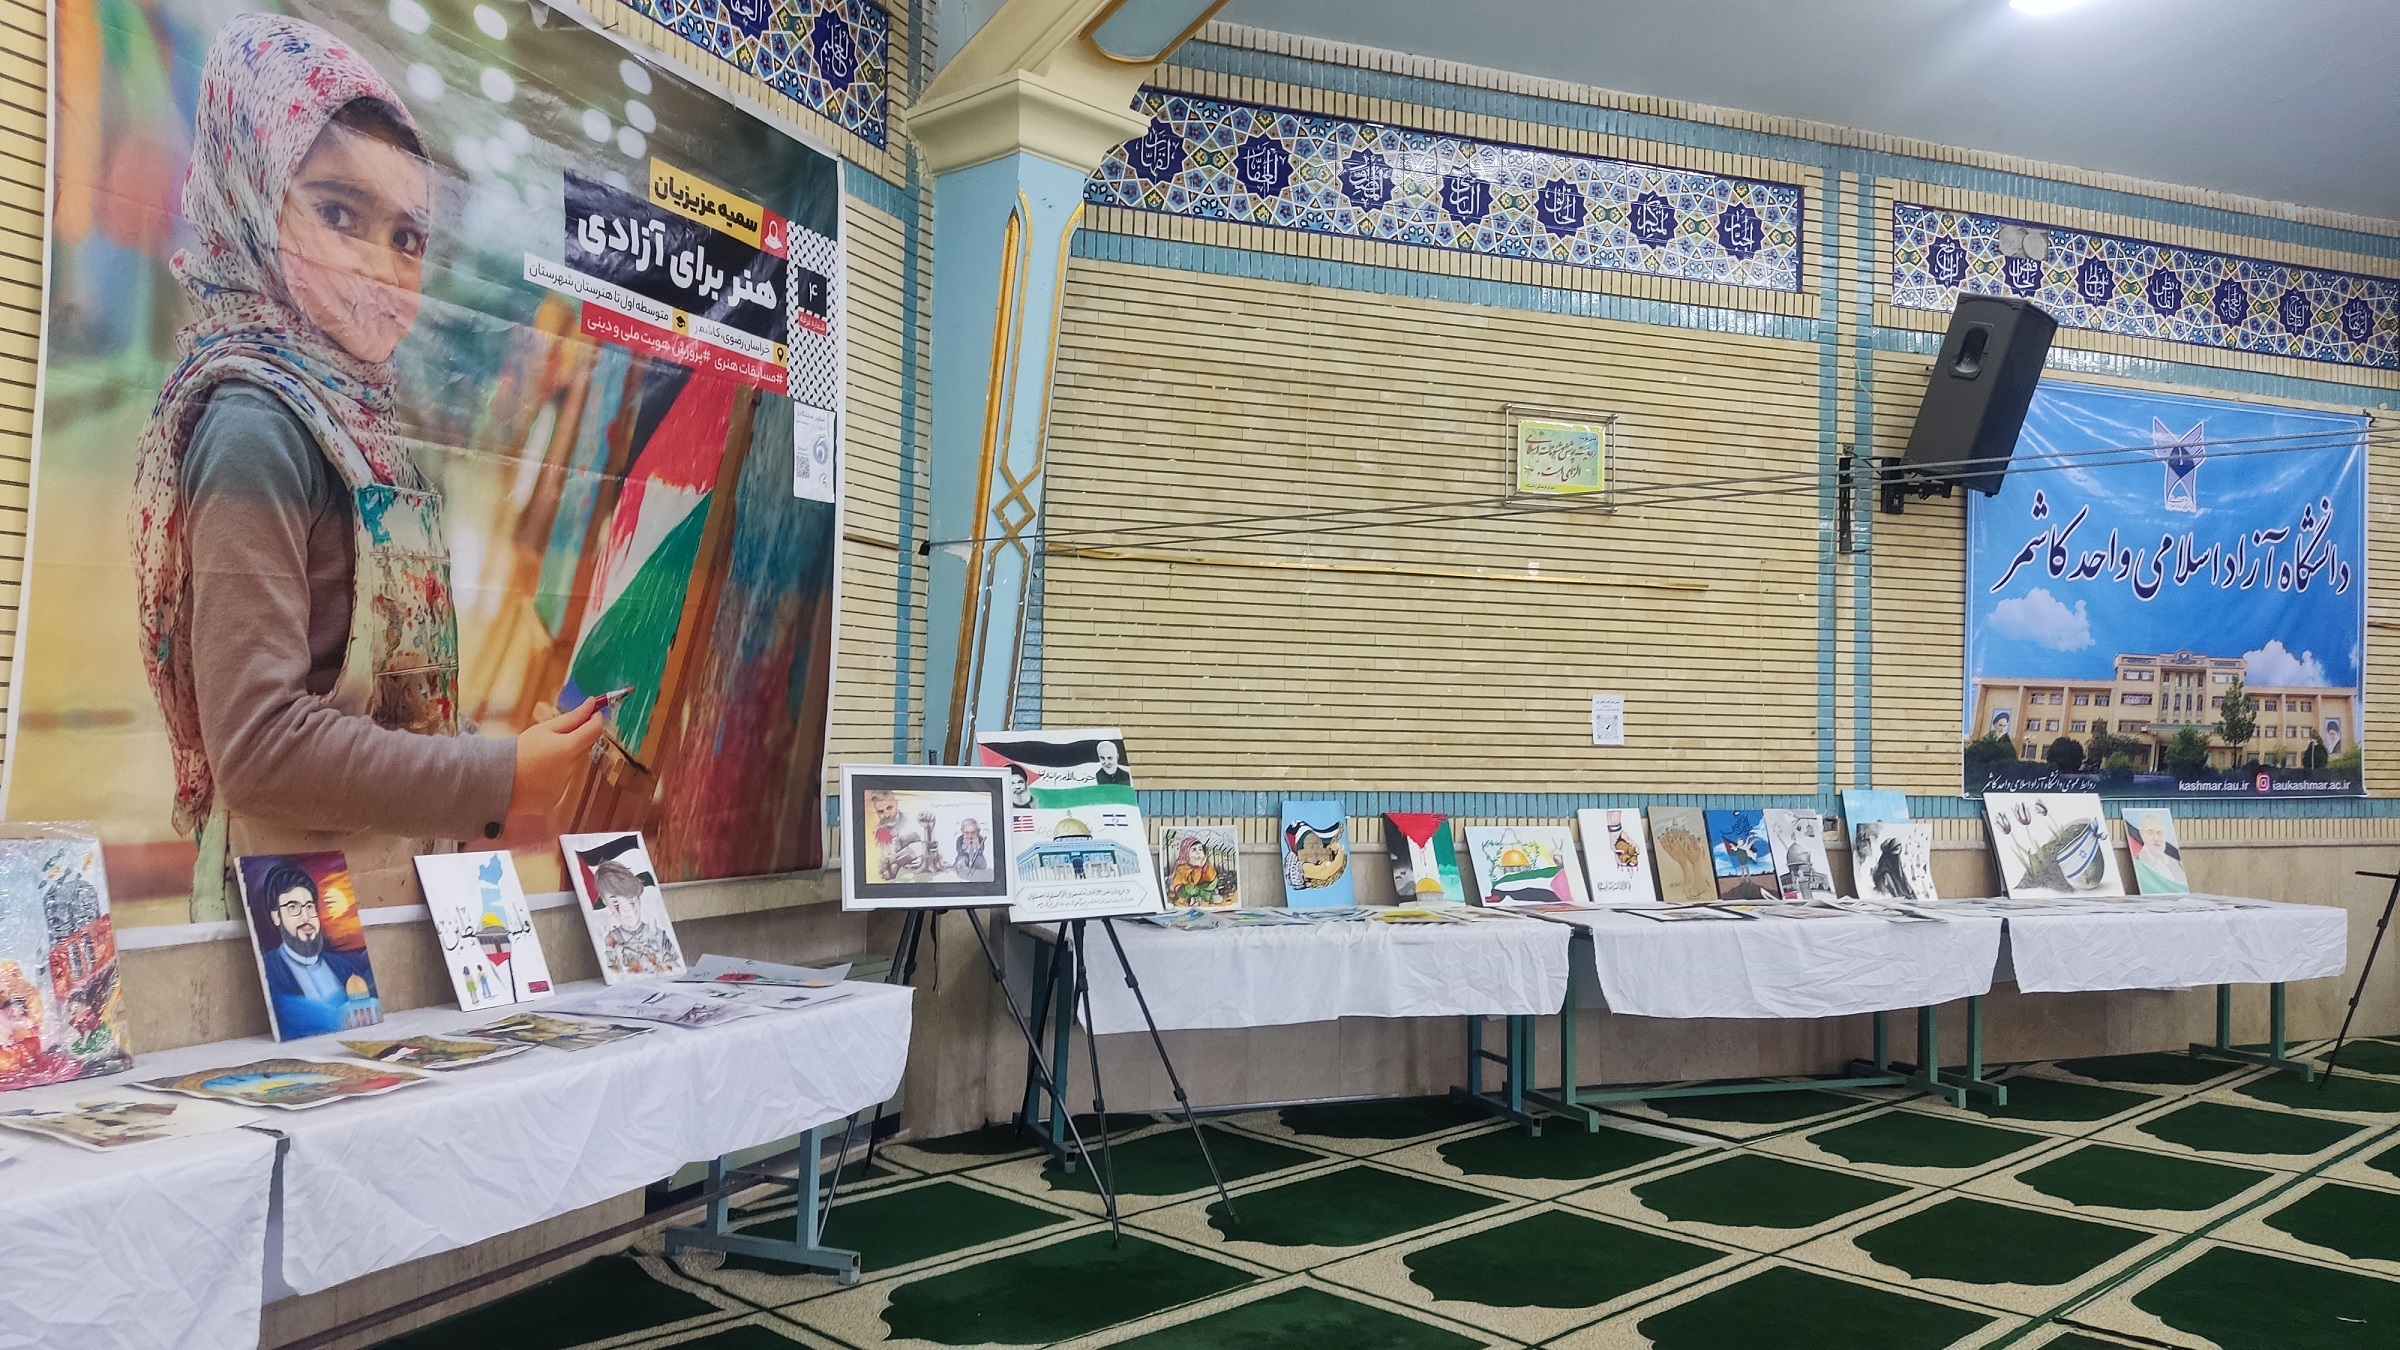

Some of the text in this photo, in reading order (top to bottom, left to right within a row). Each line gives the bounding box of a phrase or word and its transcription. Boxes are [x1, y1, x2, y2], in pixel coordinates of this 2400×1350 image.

[654, 176, 758, 233] سمیه عزیزیان
[577, 213, 778, 310] هنر برای آزادی
[529, 262, 669, 323] متوسطه اول تا هنرستان شهرستان
[587, 316, 611, 332] دینی
[613, 325, 620, 337] و
[694, 321, 720, 339] کاشمر
[620, 325, 640, 343] ملی
[641, 333, 671, 351] هویت
[745, 337, 770, 355] خراسان
[714, 356, 738, 373] هنری
[1989, 489, 2351, 601] دانشگاه آزاد اسلامی واحد کاشمر
[2178, 780, 2250, 791] kashmar.iau.ir
[2272, 779, 2351, 791] iaukashmar.ac.ir
